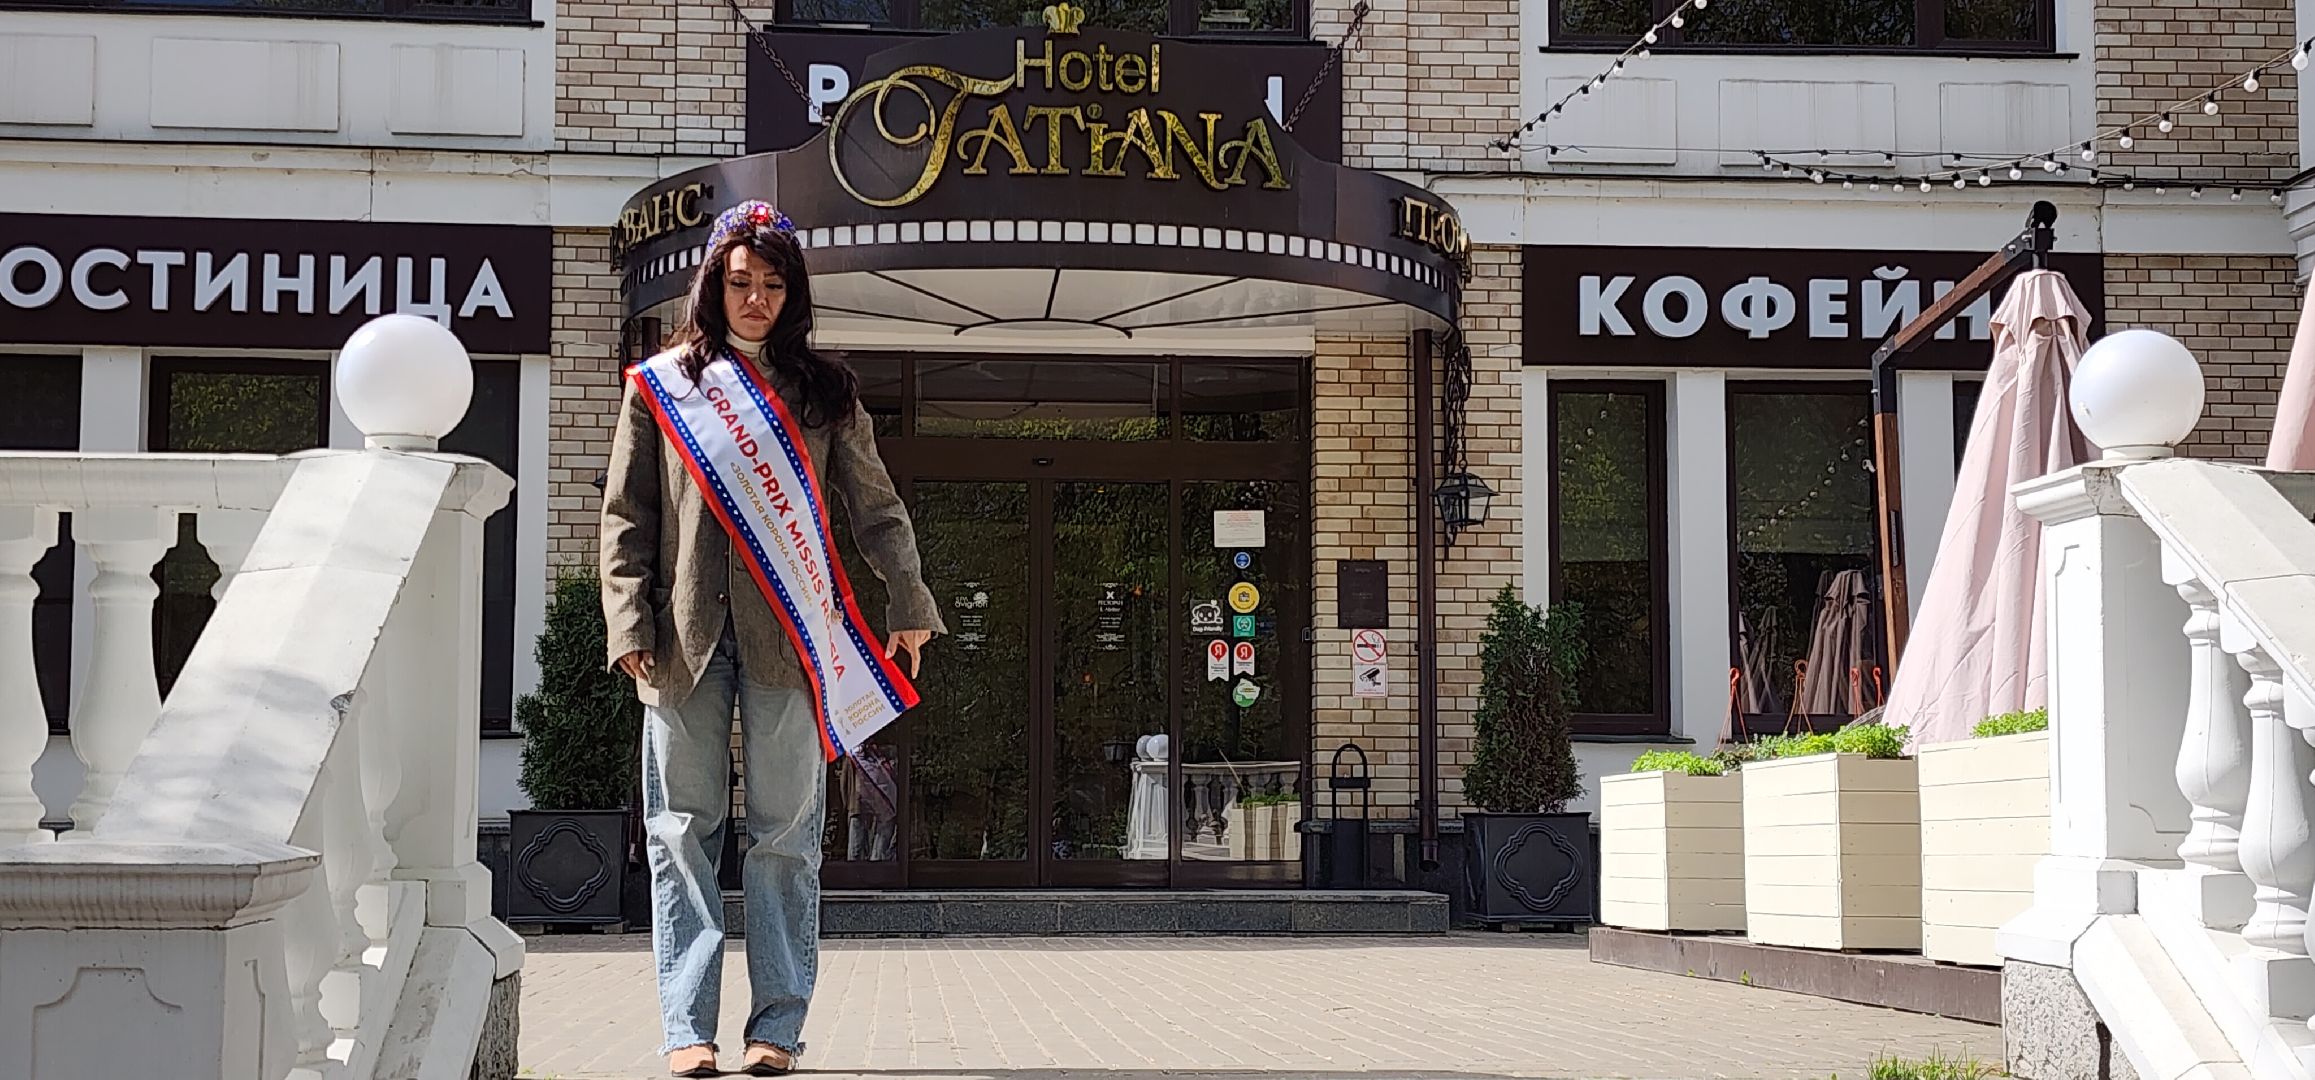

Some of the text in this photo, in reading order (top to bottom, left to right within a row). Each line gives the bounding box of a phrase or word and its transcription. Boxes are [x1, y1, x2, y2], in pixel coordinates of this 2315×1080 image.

[1015, 38, 1160, 94] Hotel
[0, 246, 515, 330] ОСТИНИЦА
[1578, 264, 1991, 341] КОФЕЙН
[706, 386, 795, 518] GRAND-PRIX
[786, 518, 825, 594] MISSIS
[761, 513, 790, 559] КОРОНА
